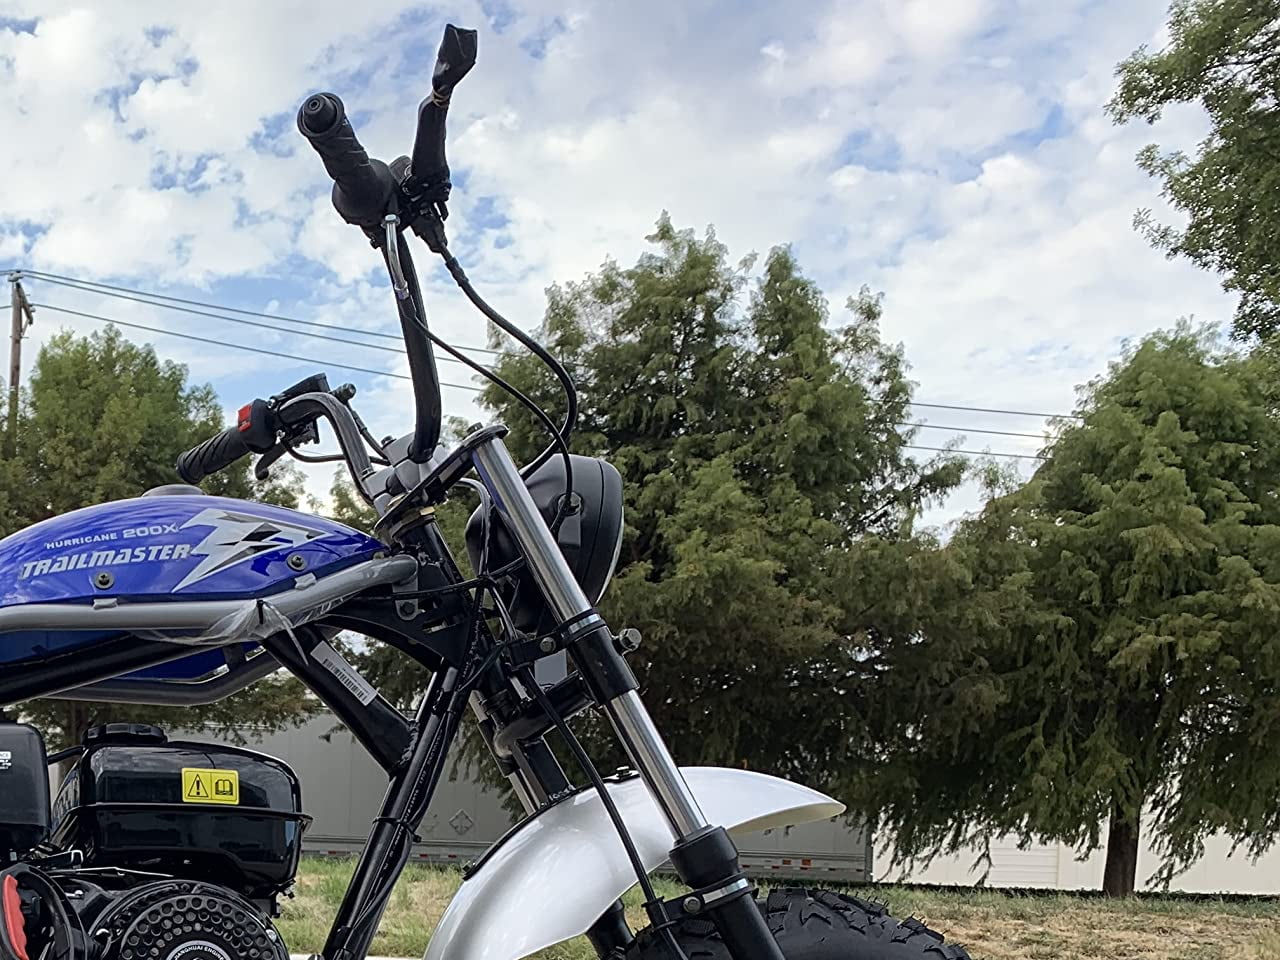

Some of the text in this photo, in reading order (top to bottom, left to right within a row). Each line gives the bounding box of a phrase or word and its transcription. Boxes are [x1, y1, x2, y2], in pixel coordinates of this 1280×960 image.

[46, 523, 178, 549] HURRICANE 200X
[21, 543, 192, 579] TRAILMASTER
